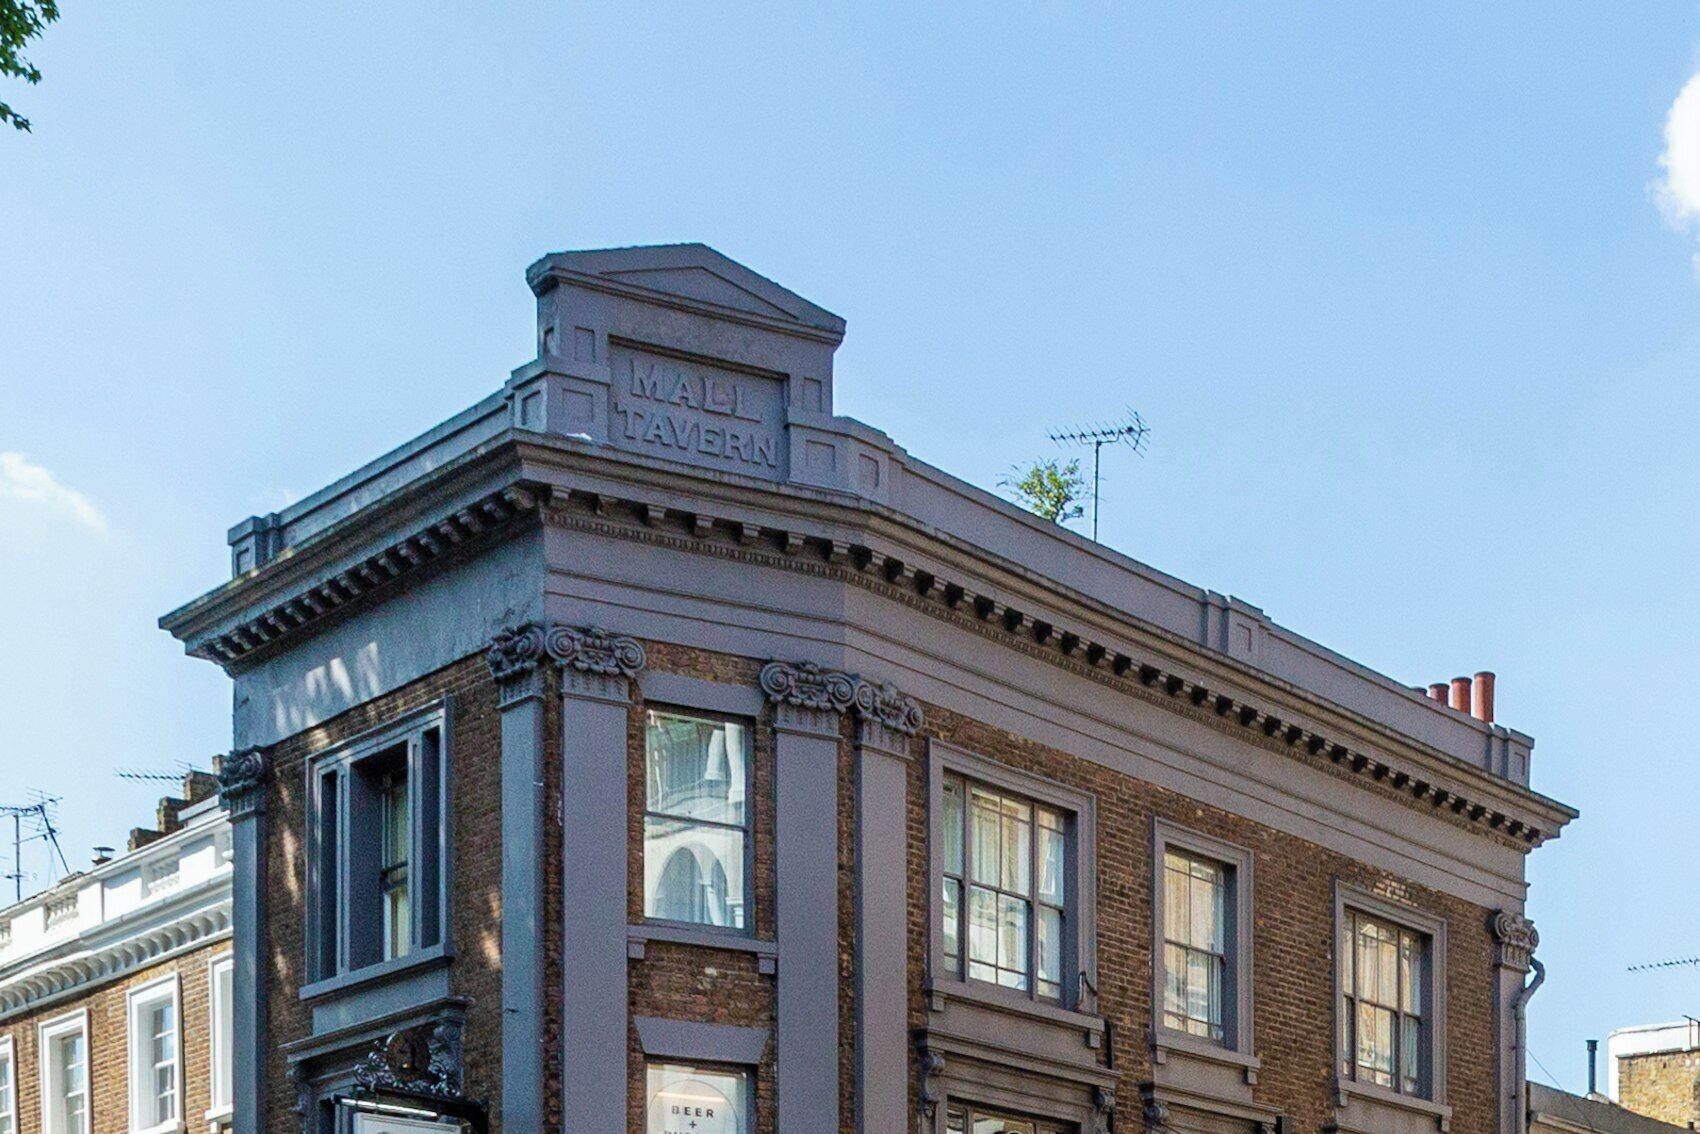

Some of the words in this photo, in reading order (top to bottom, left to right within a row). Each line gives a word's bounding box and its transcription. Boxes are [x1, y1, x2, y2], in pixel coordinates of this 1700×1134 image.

[629, 357, 763, 424] MALL
[613, 401, 778, 468] TAVERN
[671, 1105, 714, 1118] BEER
